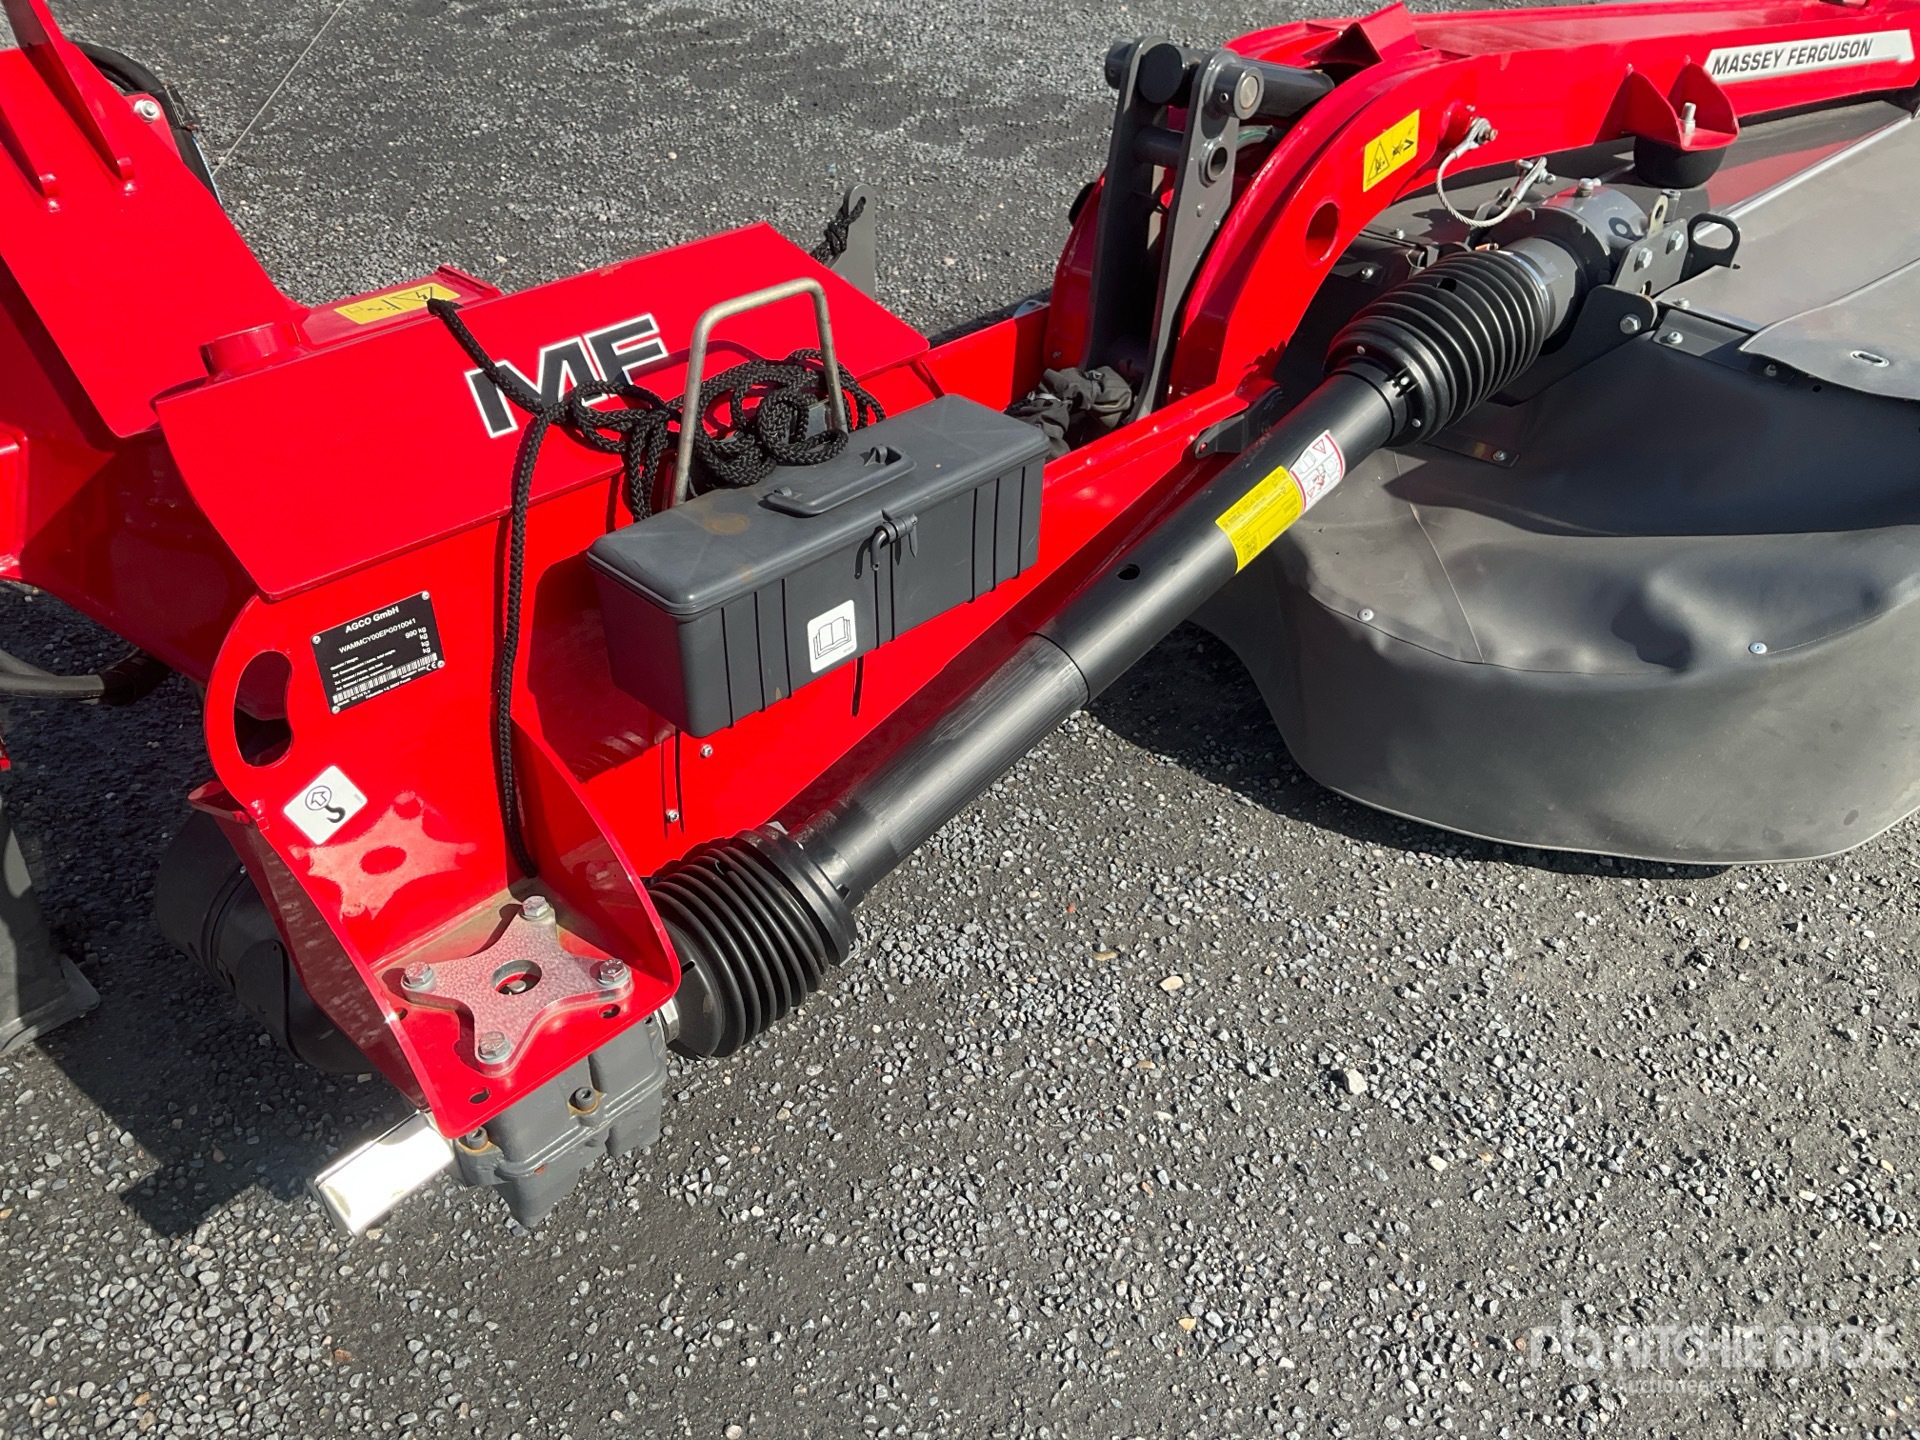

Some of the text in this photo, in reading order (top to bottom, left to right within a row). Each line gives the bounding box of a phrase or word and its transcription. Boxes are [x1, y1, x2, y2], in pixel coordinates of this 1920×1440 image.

[1712, 38, 1874, 76] MASSEY FERGUSON
[464, 313, 669, 439] MF
[345, 605, 400, 634] AGCO GmbH
[418, 626, 427, 634] kg
